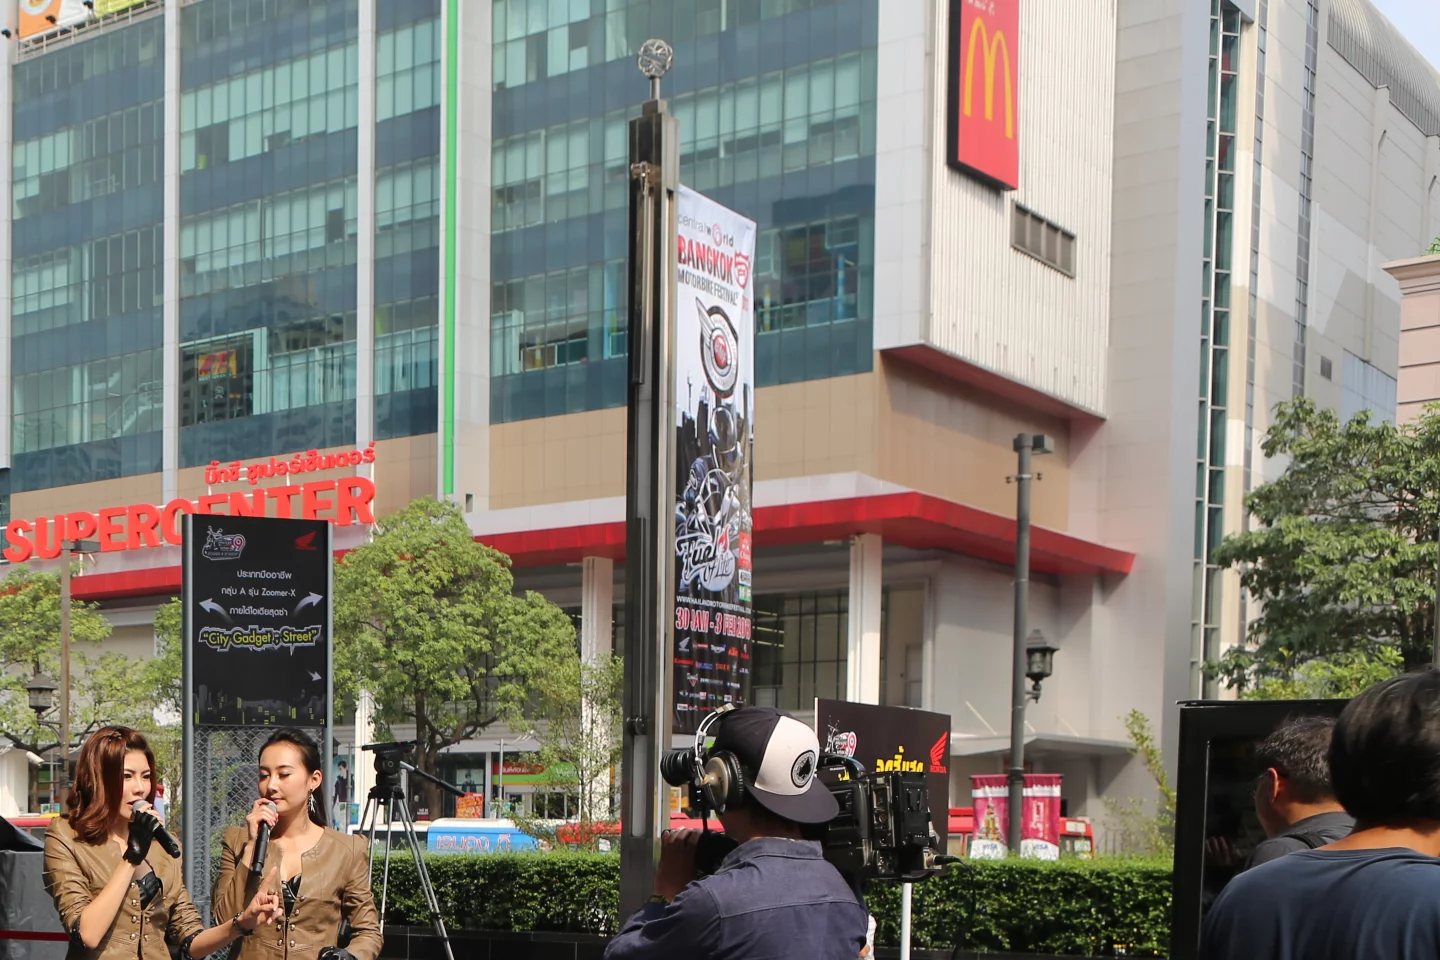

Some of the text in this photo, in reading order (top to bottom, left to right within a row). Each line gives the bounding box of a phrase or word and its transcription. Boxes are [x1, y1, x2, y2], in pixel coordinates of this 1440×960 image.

[677, 233, 733, 285] BANGKOK
[677, 268, 713, 296] MOTORBIKE
[261, 587, 296, 597] Zoomer-X
[714, 612, 723, 635] 3
[232, 630, 272, 647] Gadget
